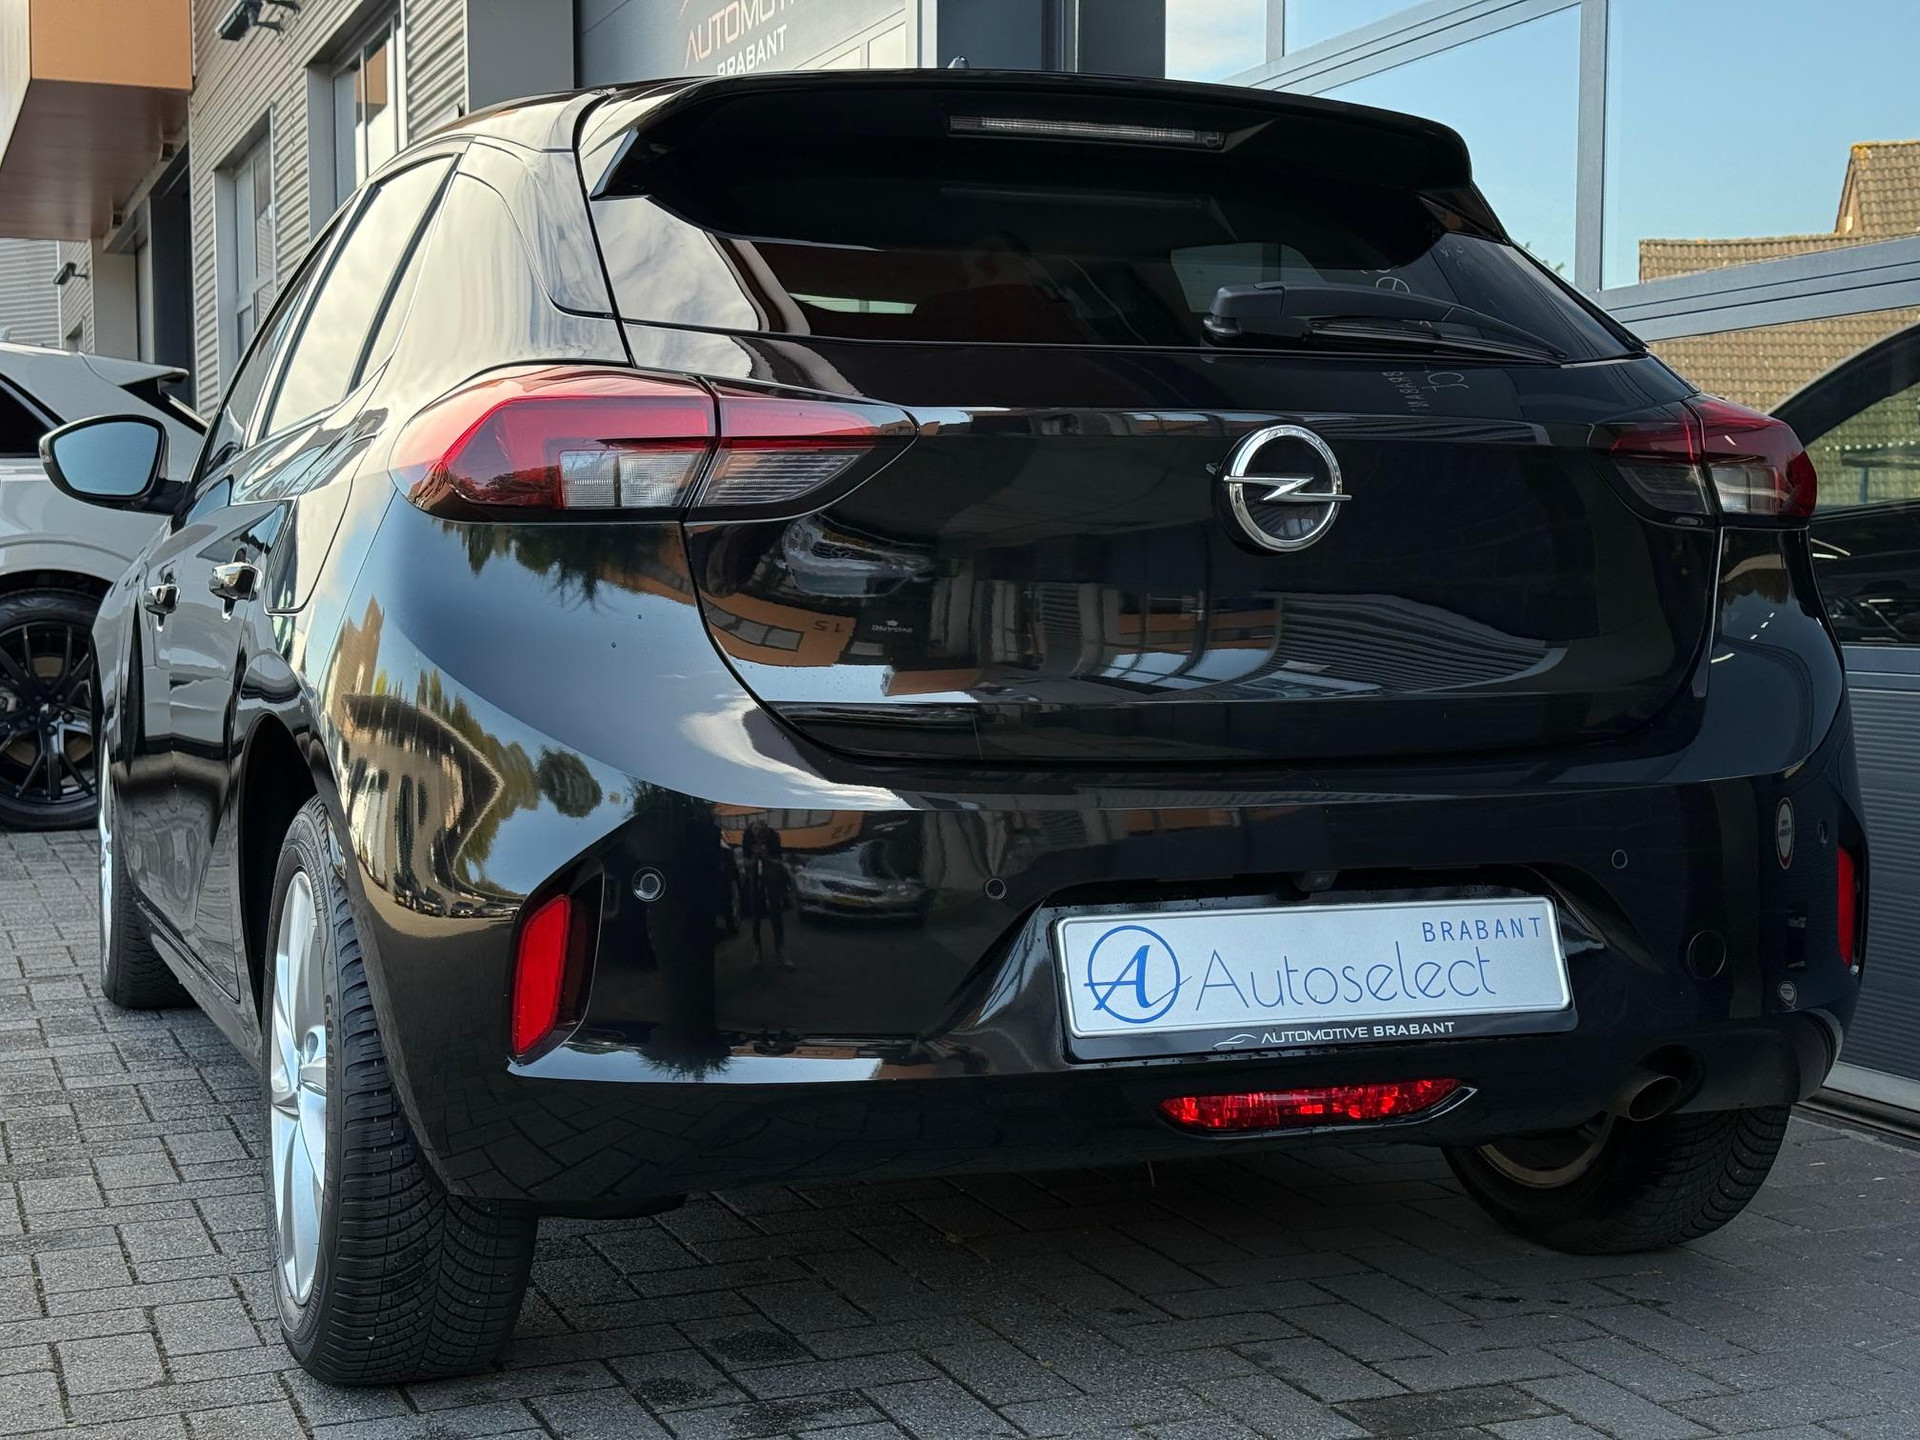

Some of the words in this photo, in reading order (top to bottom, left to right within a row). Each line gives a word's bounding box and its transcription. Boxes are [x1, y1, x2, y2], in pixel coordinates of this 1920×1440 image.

[1422, 917, 1541, 943] BRABANT
[1196, 940, 1497, 1011] Autoselect
[1261, 1026, 1369, 1044] AUTOMOTIVE
[1373, 1021, 1456, 1038] BRABANT
